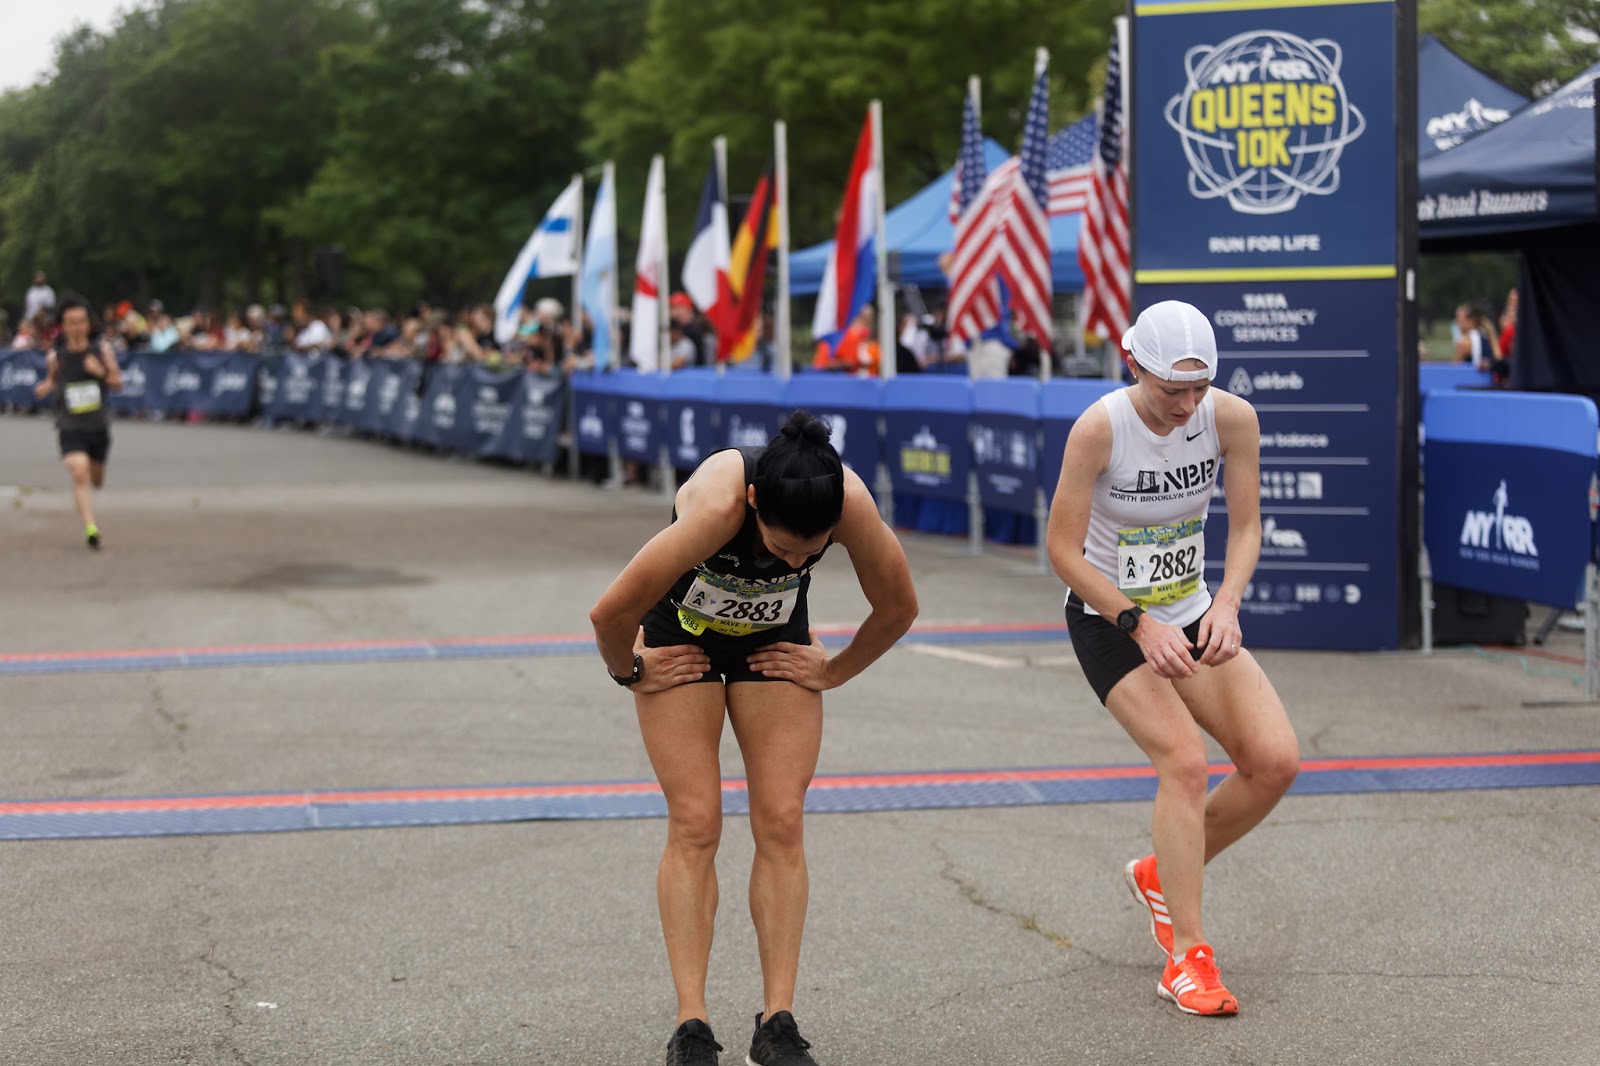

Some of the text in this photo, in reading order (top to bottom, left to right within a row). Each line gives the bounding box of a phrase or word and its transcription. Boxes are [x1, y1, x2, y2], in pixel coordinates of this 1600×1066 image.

[1191, 82, 1337, 133] QUEENS
[1236, 127, 1291, 168] 10K
[1209, 234, 1320, 253] RUN FOR LIFE
[1242, 293, 1288, 310] TATA
[1214, 309, 1317, 327] CONSULTANCY
[1232, 326, 1299, 343] SERVICES
[1164, 459, 1215, 492] NBR
[1109, 491, 1137, 502] NORTH
[1140, 491, 1184, 503] BROOKLYN
[1127, 556, 1135, 567] A
[1149, 545, 1196, 583] 2882
[1127, 568, 1136, 579] A
[696, 591, 705, 599] A
[1157, 584, 1173, 593] WAVE
[692, 598, 701, 606] A
[715, 599, 783, 622] 2883
[680, 614, 699, 631] 2883
[720, 620, 740, 628] WAVE
